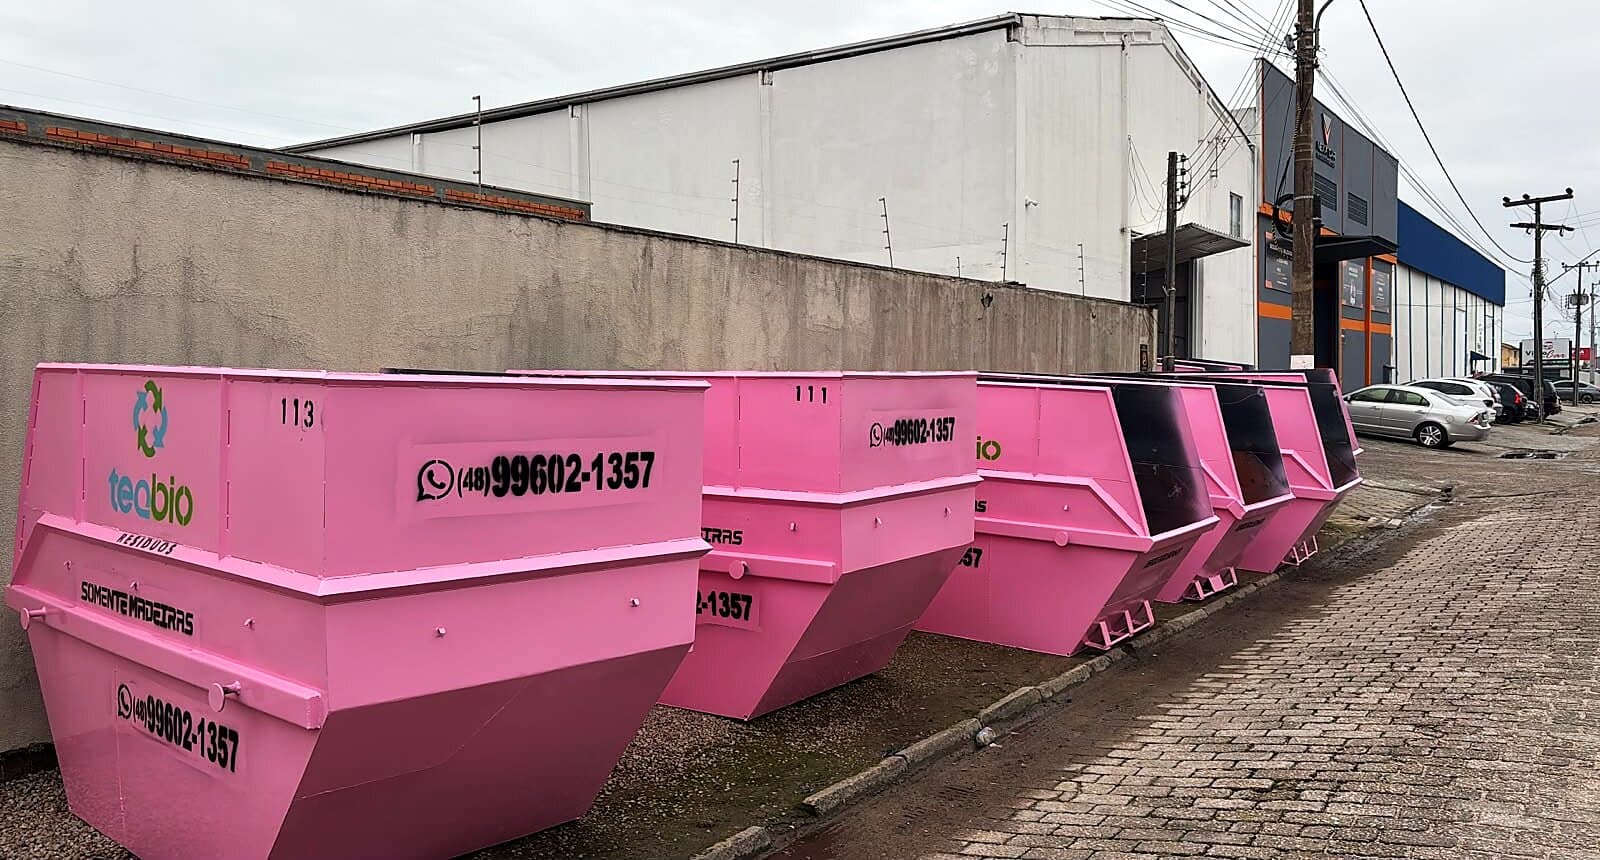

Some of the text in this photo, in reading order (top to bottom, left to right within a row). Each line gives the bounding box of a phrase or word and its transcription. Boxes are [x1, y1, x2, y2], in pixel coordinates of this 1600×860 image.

[796, 385, 828, 404] 111
[281, 397, 314, 428] 113
[116, 533, 177, 555] RESIDUOS
[81, 581, 194, 636] SOMENTE MADEIRAS
